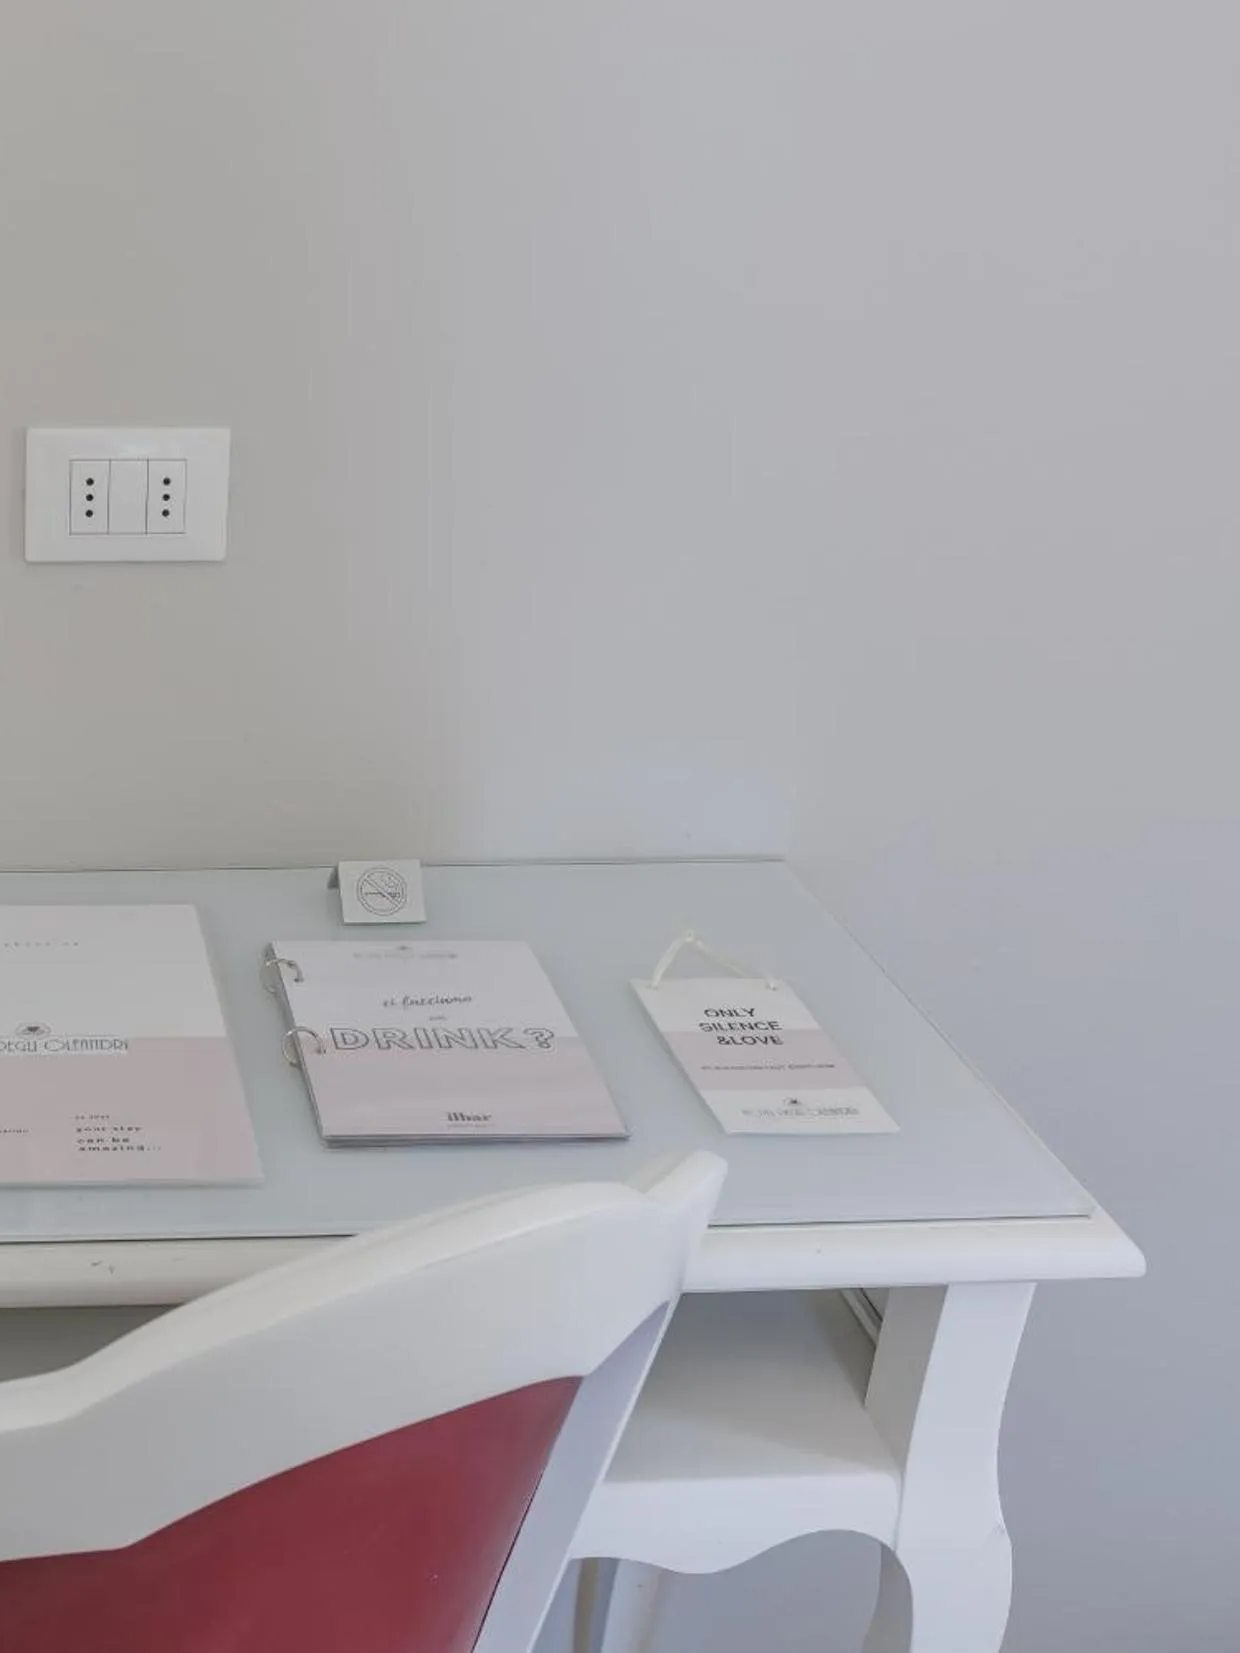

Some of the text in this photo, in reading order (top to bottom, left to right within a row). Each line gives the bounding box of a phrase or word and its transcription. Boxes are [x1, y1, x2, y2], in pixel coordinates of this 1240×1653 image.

[703, 1007, 755, 1018] ONLY
[698, 1020, 783, 1032] SILENCE
[329, 1027, 555, 1051] DRINK?
[716, 1035, 784, 1046] &LOVE
